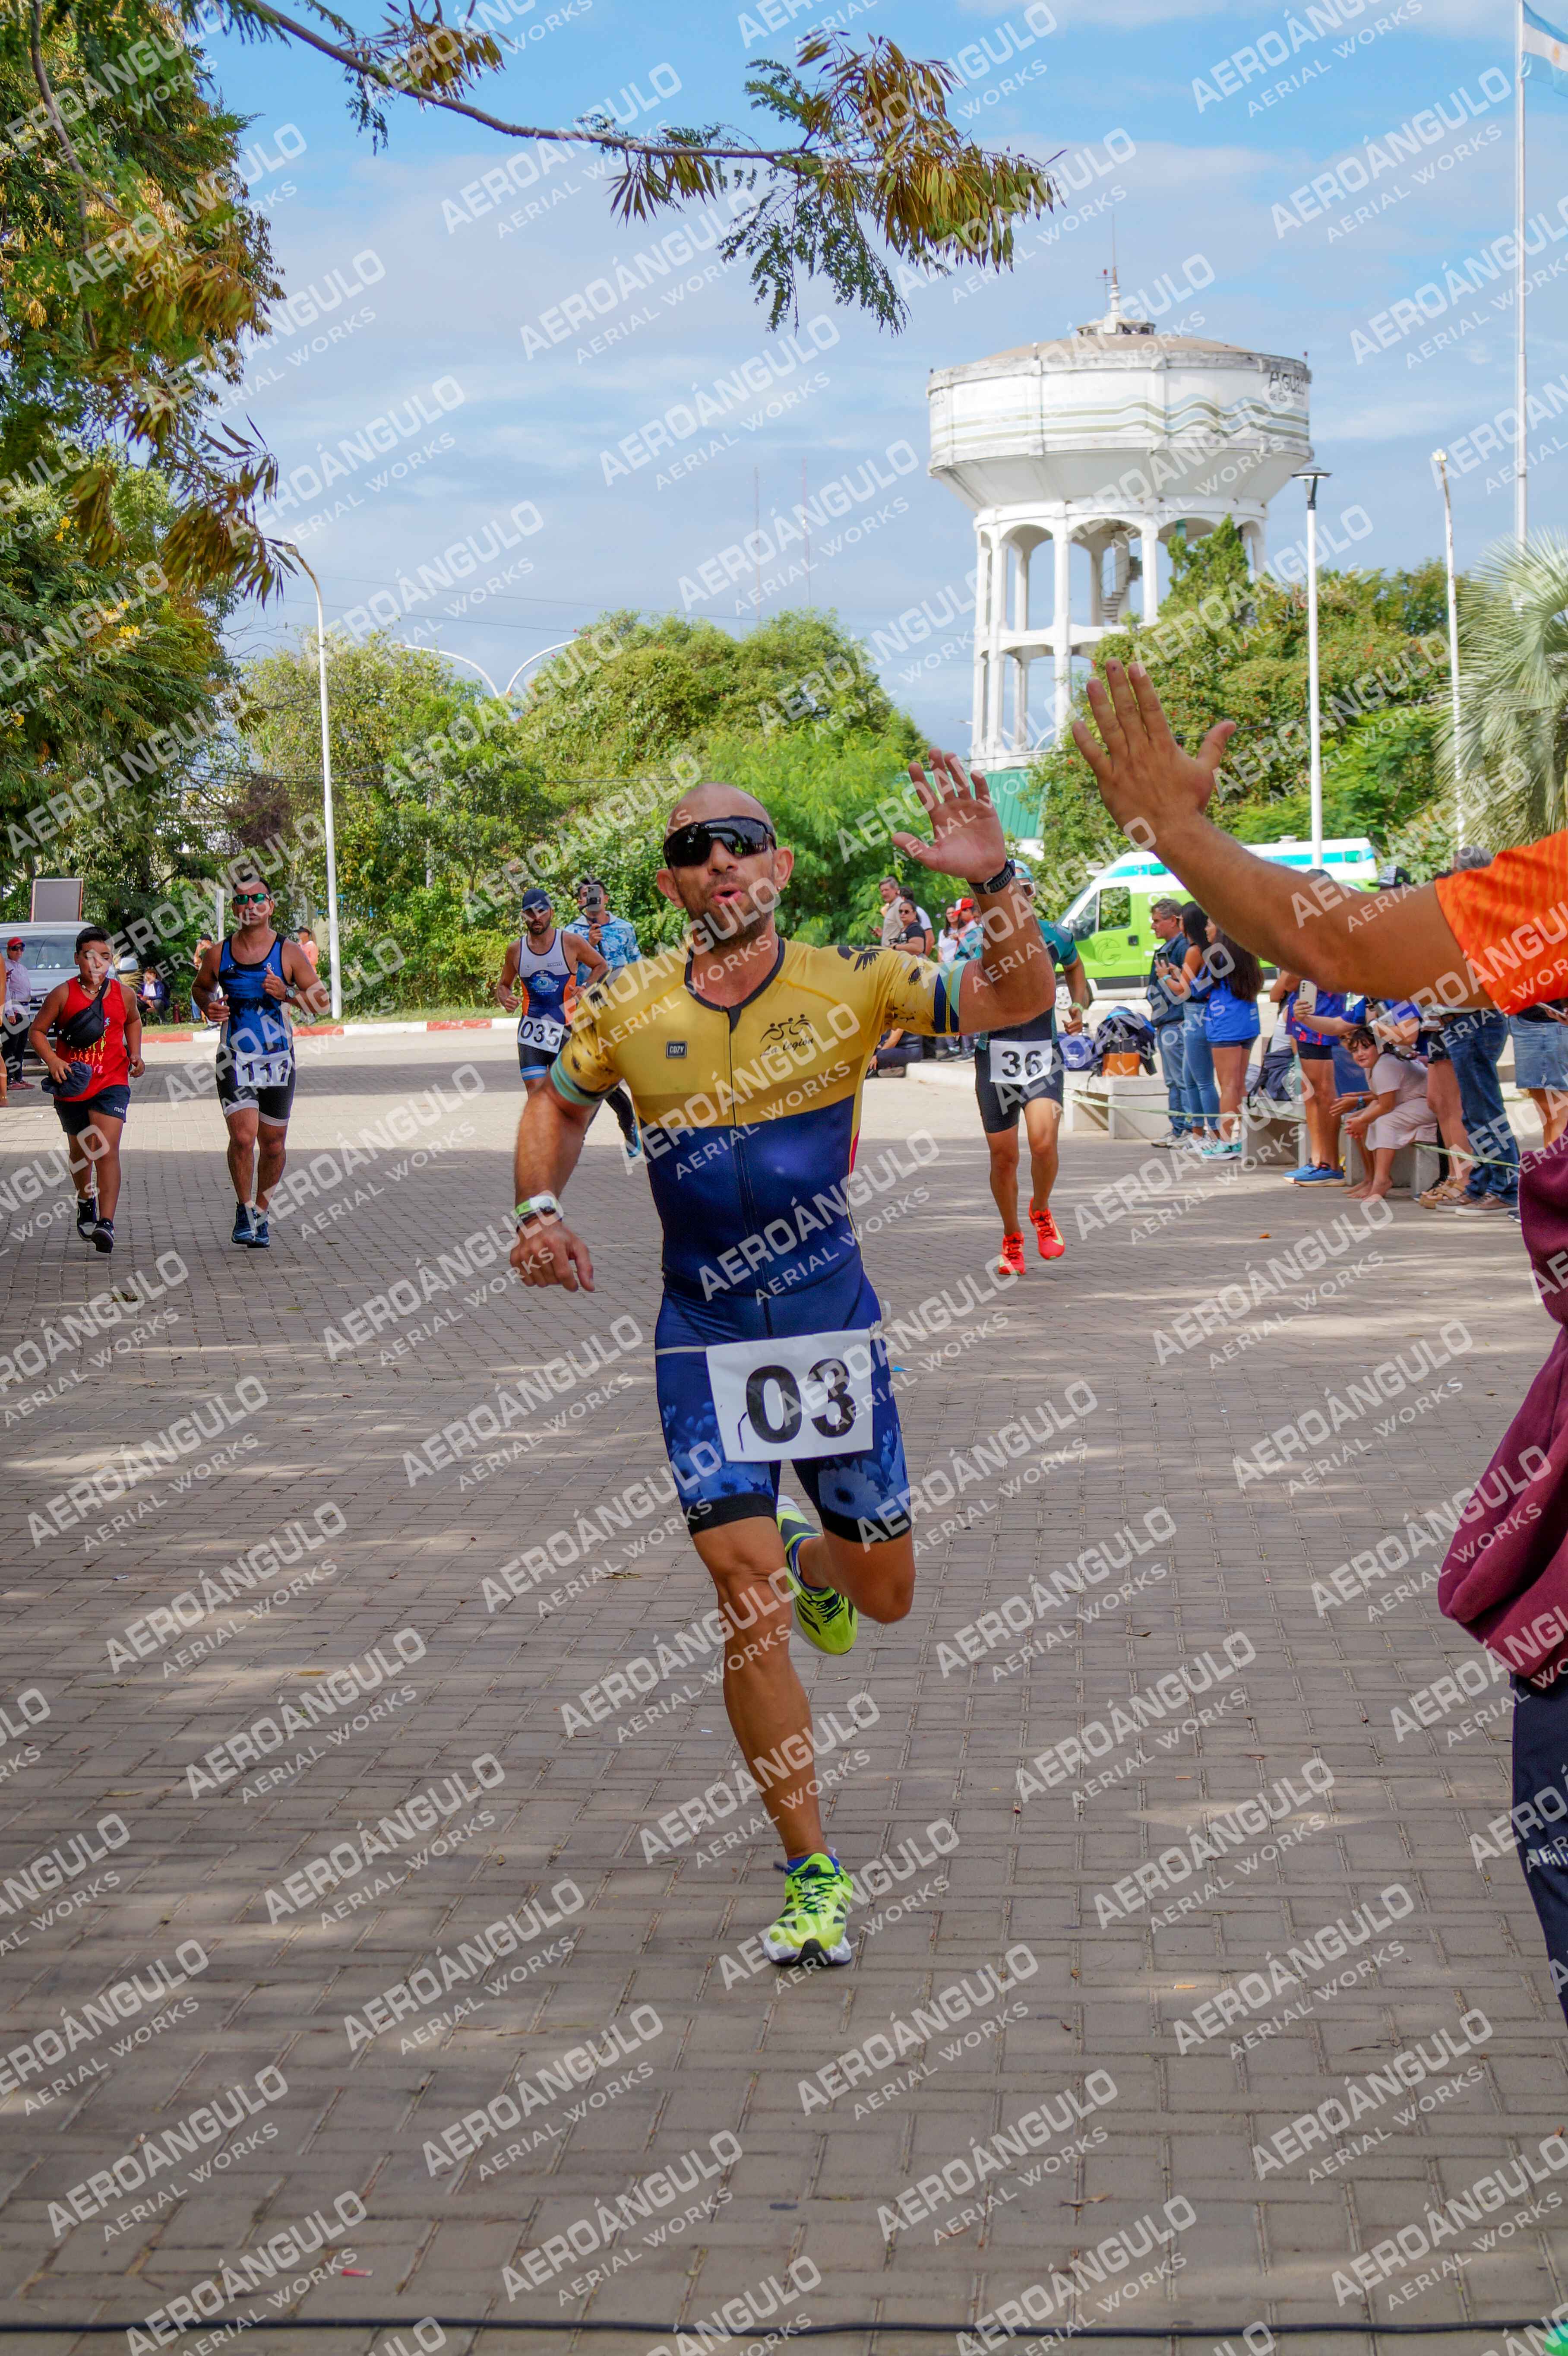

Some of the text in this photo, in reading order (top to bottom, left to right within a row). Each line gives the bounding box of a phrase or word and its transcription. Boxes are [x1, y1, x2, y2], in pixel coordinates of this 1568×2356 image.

[521, 1021, 561, 1047] 035
[242, 1059, 288, 1082] 111
[1001, 1050, 1043, 1077] 36
[746, 1358, 857, 1443] 03
